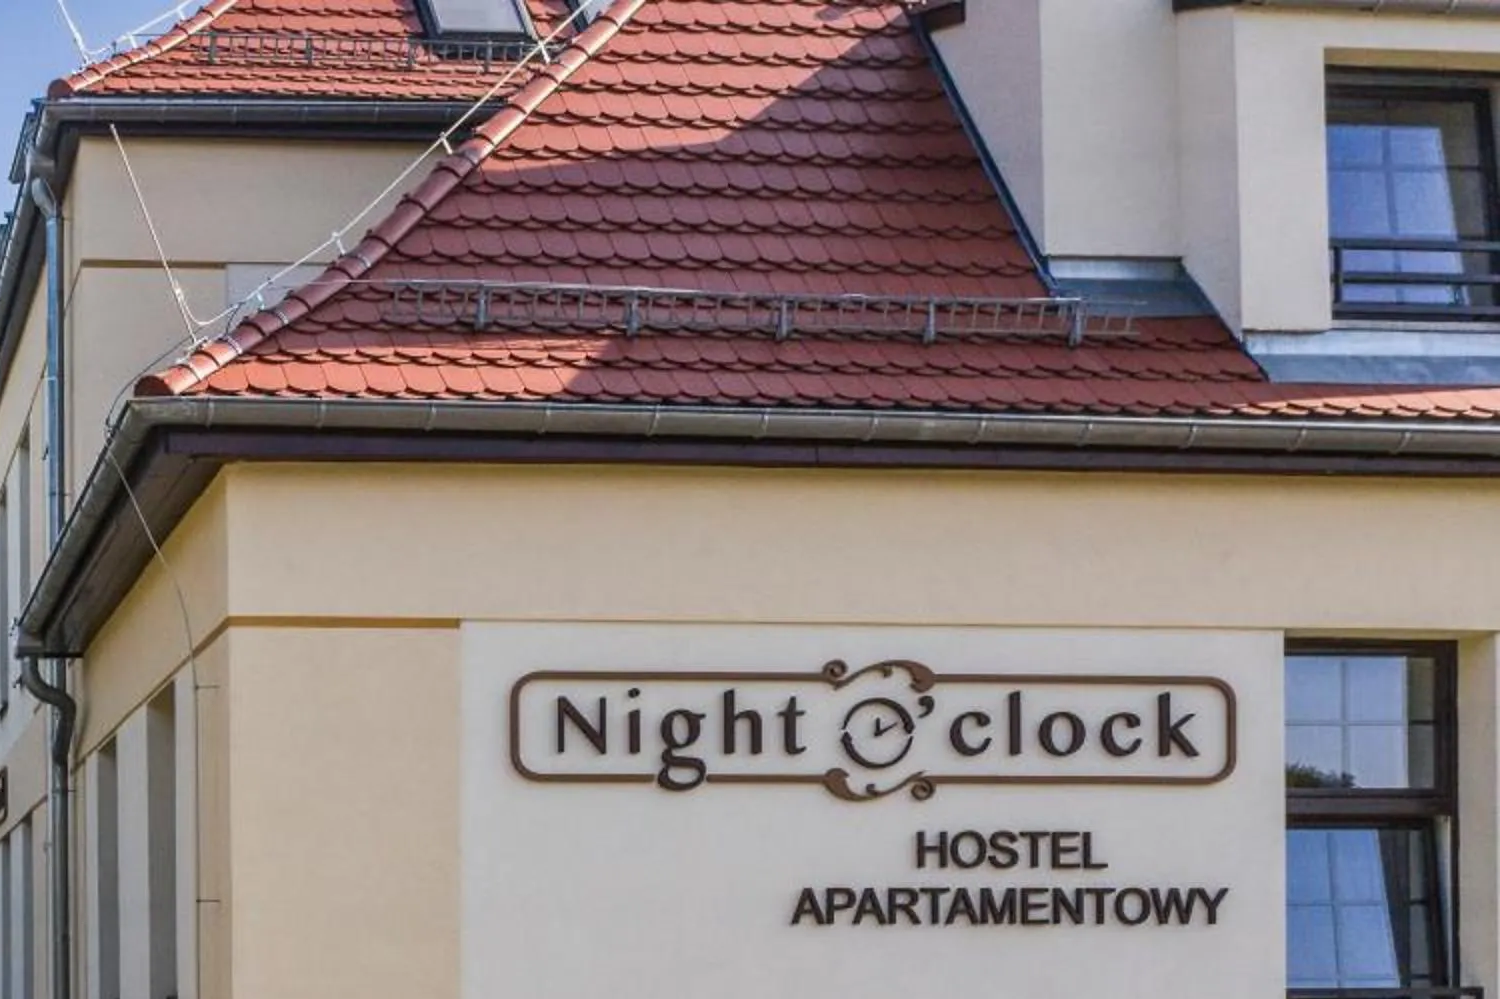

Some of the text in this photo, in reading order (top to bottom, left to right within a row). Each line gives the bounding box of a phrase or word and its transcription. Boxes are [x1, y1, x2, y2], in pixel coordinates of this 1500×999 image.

[556, 688, 806, 792] Night
[915, 830, 1109, 871] HOSTEL
[790, 886, 1228, 927] APARTAMENTOWY
